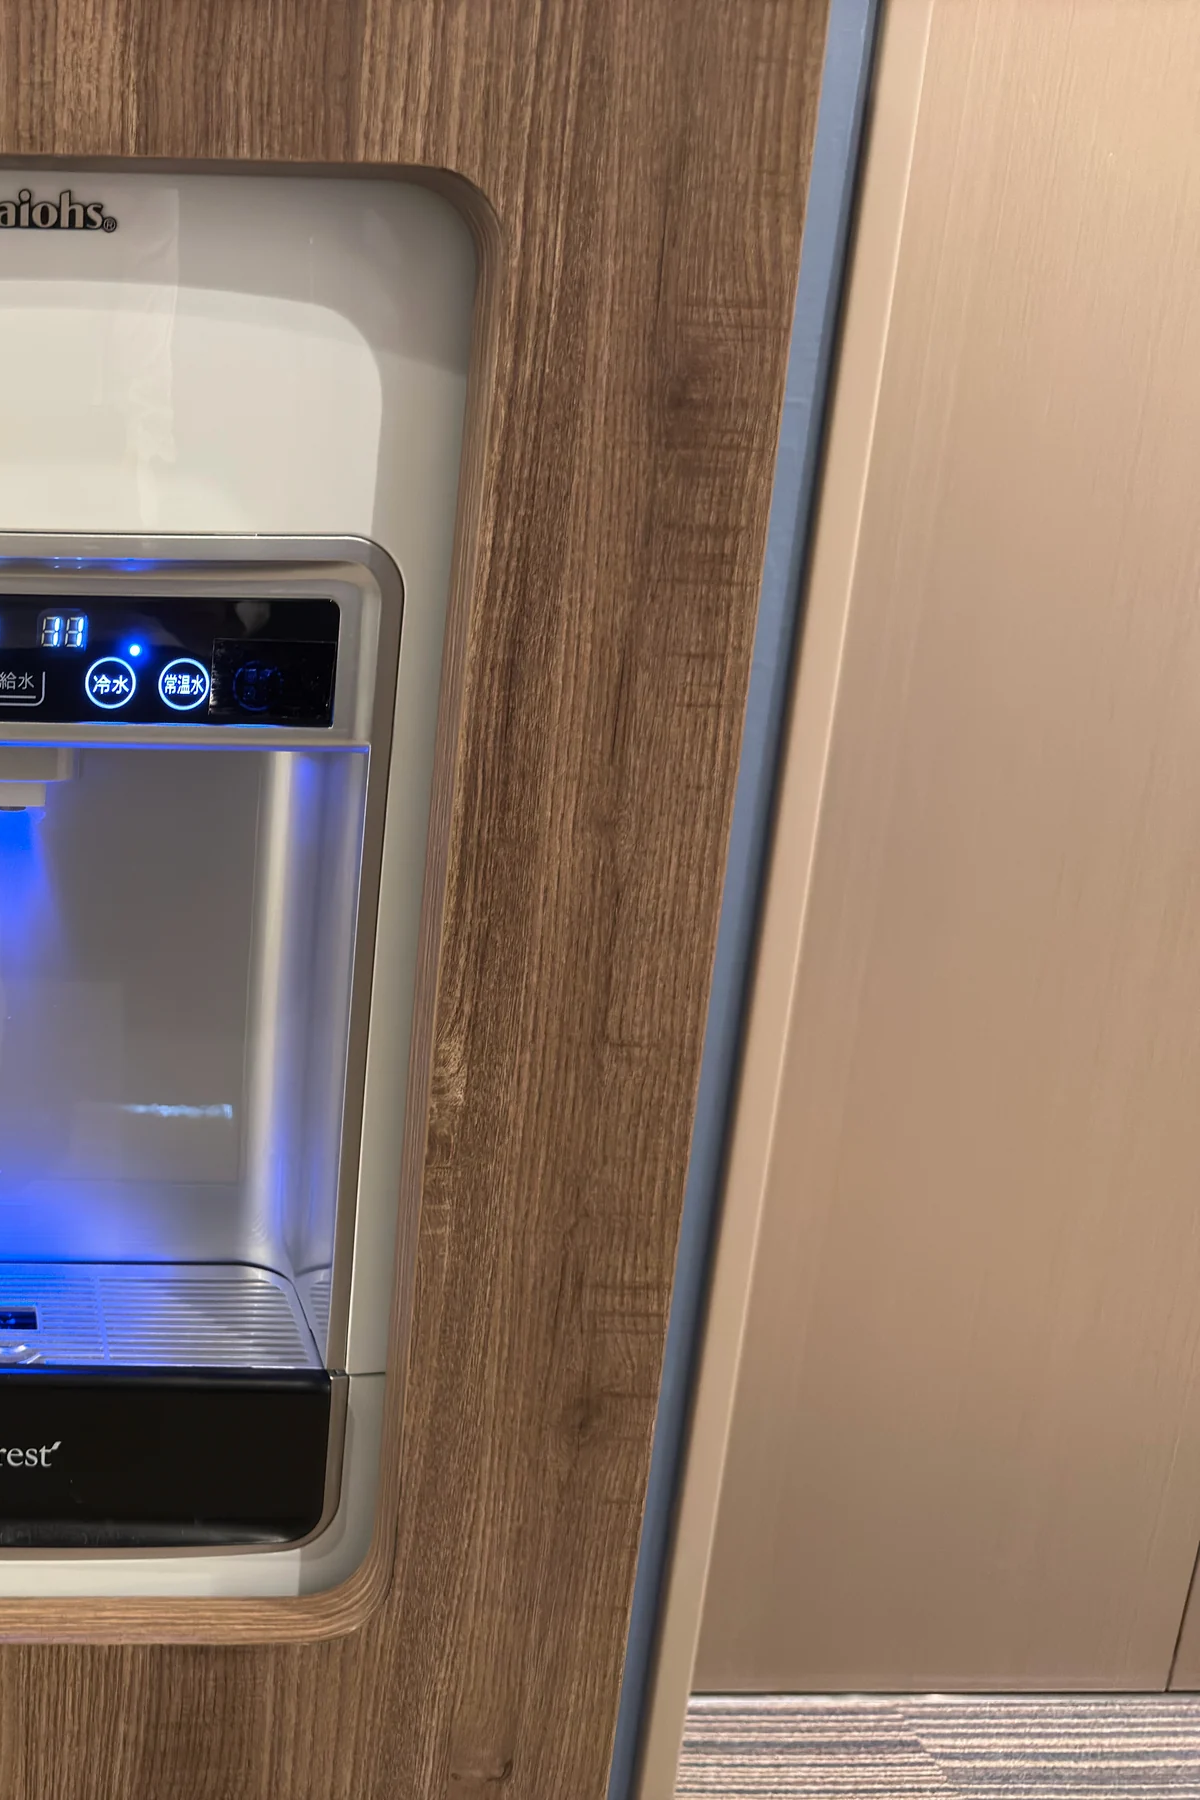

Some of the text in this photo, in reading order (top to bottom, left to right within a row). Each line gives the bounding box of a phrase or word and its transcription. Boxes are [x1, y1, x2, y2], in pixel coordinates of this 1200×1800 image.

[92, 674, 130, 695] 冷水
[164, 674, 205, 695] 常温水
